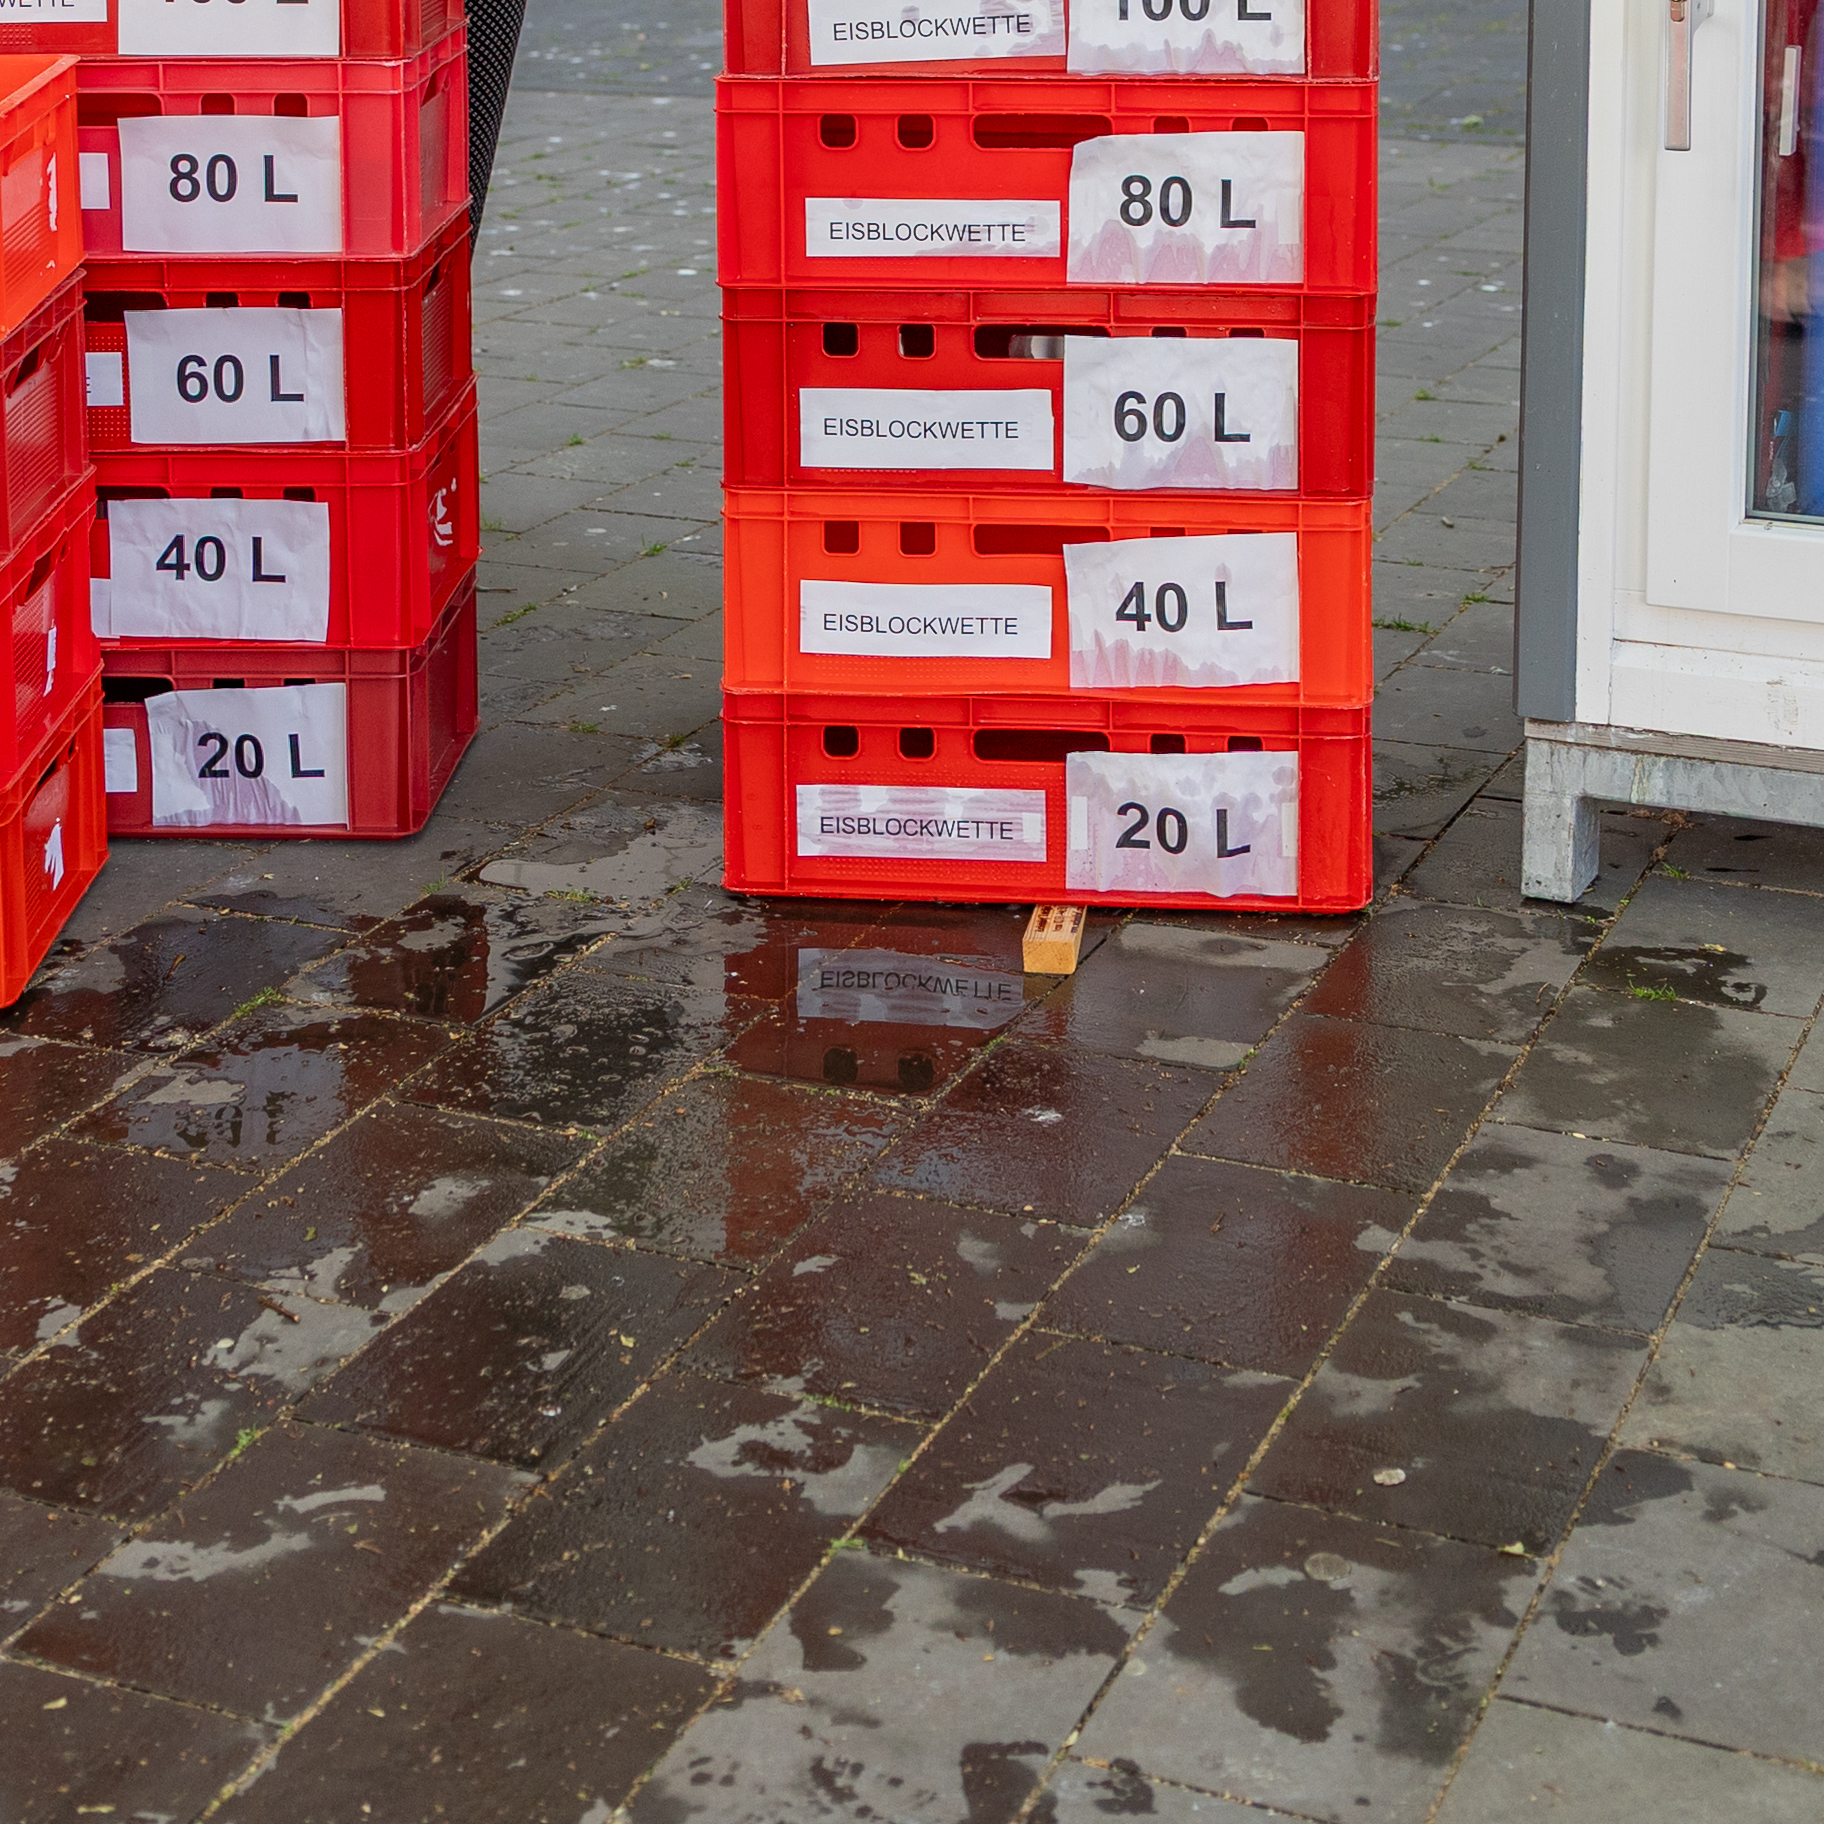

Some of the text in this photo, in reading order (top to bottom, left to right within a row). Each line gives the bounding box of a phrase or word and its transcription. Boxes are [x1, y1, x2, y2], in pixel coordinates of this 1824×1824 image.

[834, 15, 1030, 40] EISBLOCKWETTE
[170, 154, 298, 202] 80 L
[1120, 176, 1256, 228] 80 L
[831, 223, 1025, 241] EISBLOCKWETTE
[177, 355, 304, 403] 60 L
[825, 419, 1018, 438] EISBLOCKWETTE
[1115, 391, 1250, 442] 60 L
[156, 535, 286, 583] 40 L
[824, 614, 1017, 634] EISBLOCKWETTE
[1116, 582, 1252, 632] 40 L
[197, 732, 325, 779] 20 L
[821, 817, 1013, 839] EISBLOCKWETTE
[1116, 802, 1250, 858] 20 L
